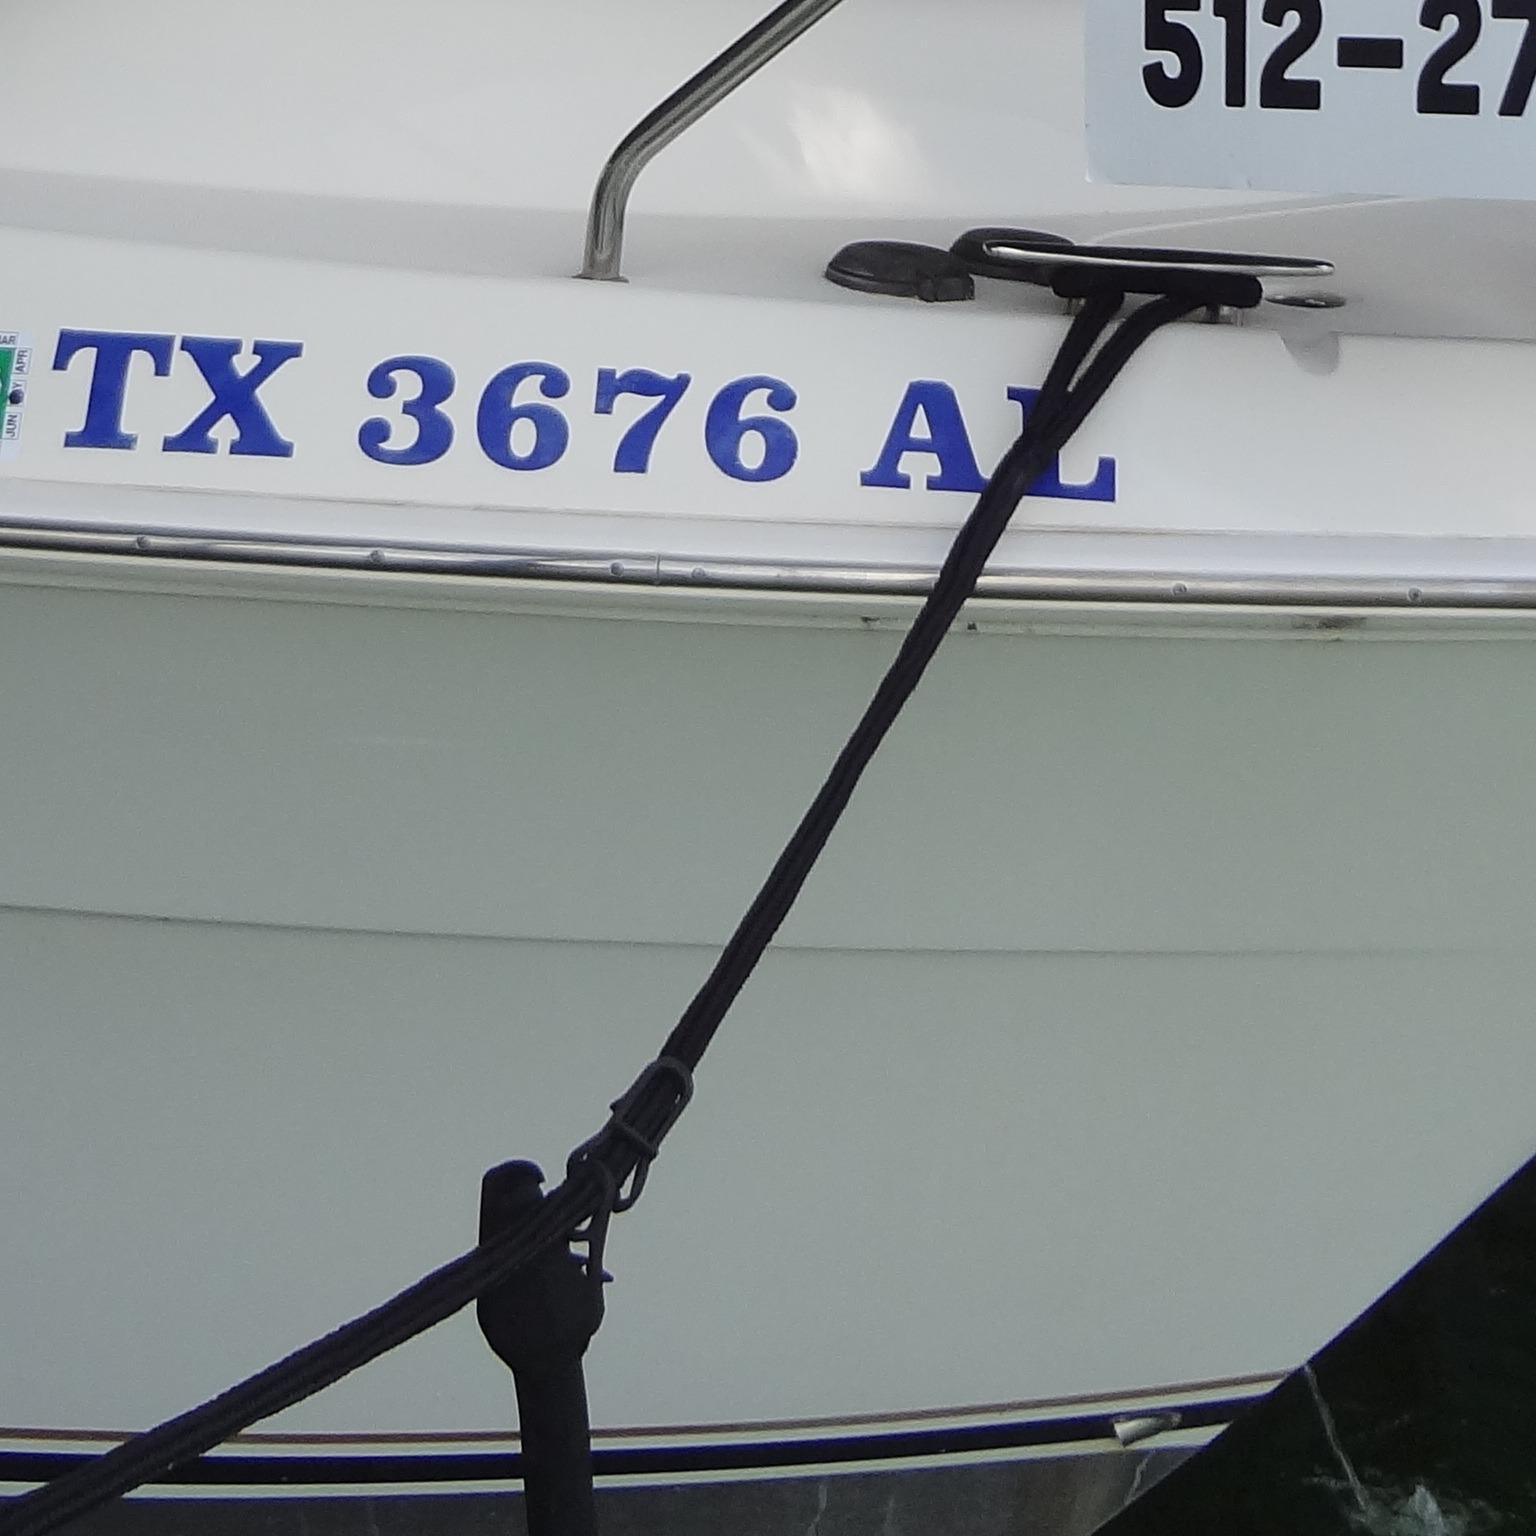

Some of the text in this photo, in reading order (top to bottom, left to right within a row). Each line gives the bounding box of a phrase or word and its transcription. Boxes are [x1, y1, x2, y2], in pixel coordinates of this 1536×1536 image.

[15, 350, 28, 373] APR
[52, 329, 303, 458] TX
[357, 355, 798, 482] 3676
[5, 414, 18, 437] JUN
